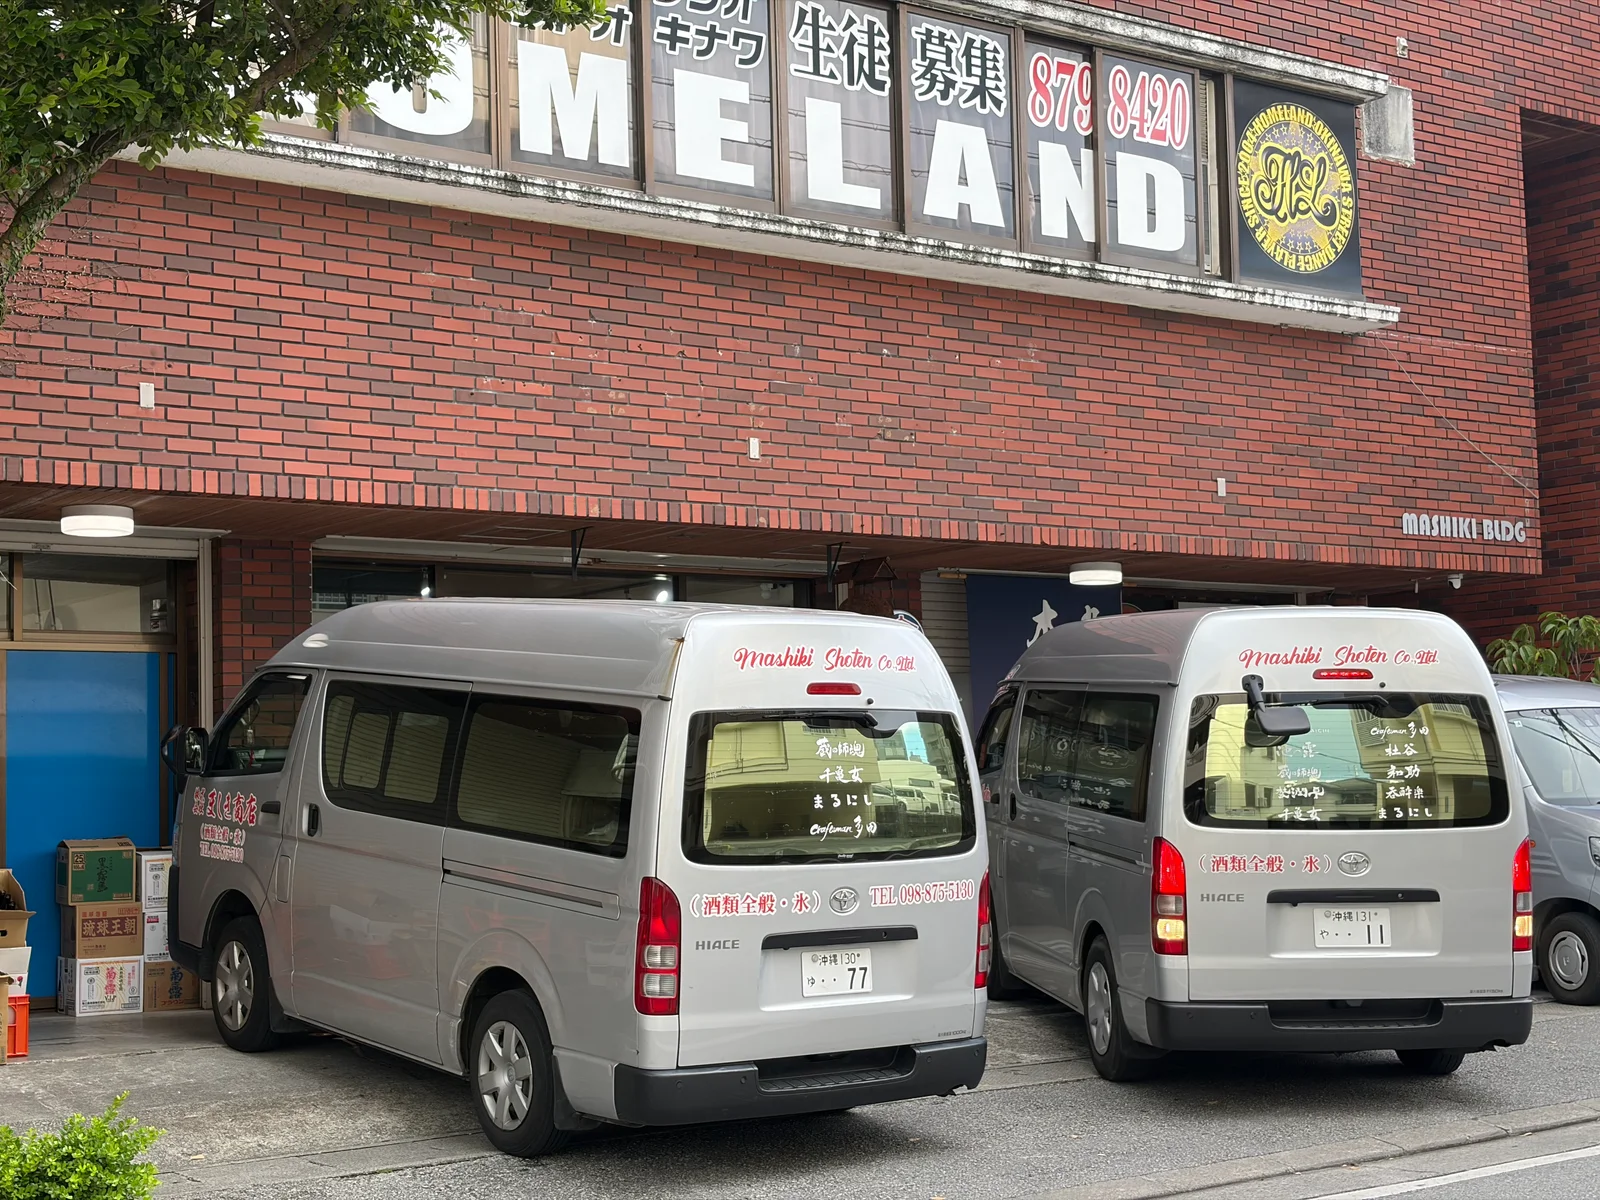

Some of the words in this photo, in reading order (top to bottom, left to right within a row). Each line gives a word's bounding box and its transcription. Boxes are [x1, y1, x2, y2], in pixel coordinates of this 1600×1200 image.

[1027, 51, 1094, 137] 879
[1107, 64, 1192, 151] 8420
[1251, 104, 1314, 134] HOMELAND
[1237, 127, 1257, 177] 2004
[1313, 120, 1353, 193] OKINAWA
[1237, 174, 1260, 230] SINCE
[1332, 196, 1353, 253] STREET
[1254, 228, 1297, 269] PLAYER
[1295, 247, 1337, 271] DANCE
[1402, 512, 1478, 540] MASHIKI
[1482, 518, 1527, 543] BLDG
[734, 646, 814, 670] Mashiki
[823, 647, 874, 671] Shoten
[1238, 646, 1323, 667] Mashiki
[1333, 645, 1388, 667] Shoten
[1370, 725, 1408, 740] Craftsman
[1408, 721, 1430, 738] 多田
[814, 794, 873, 809] まるにし
[1378, 807, 1433, 820] まるにし
[810, 822, 853, 842] Craftsman
[852, 815, 878, 839] 多田
[868, 886, 898, 907] TEL
[899, 879, 975, 905] 098-875-5130
[1200, 893, 1245, 903] HIACE
[82, 917, 137, 937] 琉球王朝
[695, 939, 740, 951] HIACE
